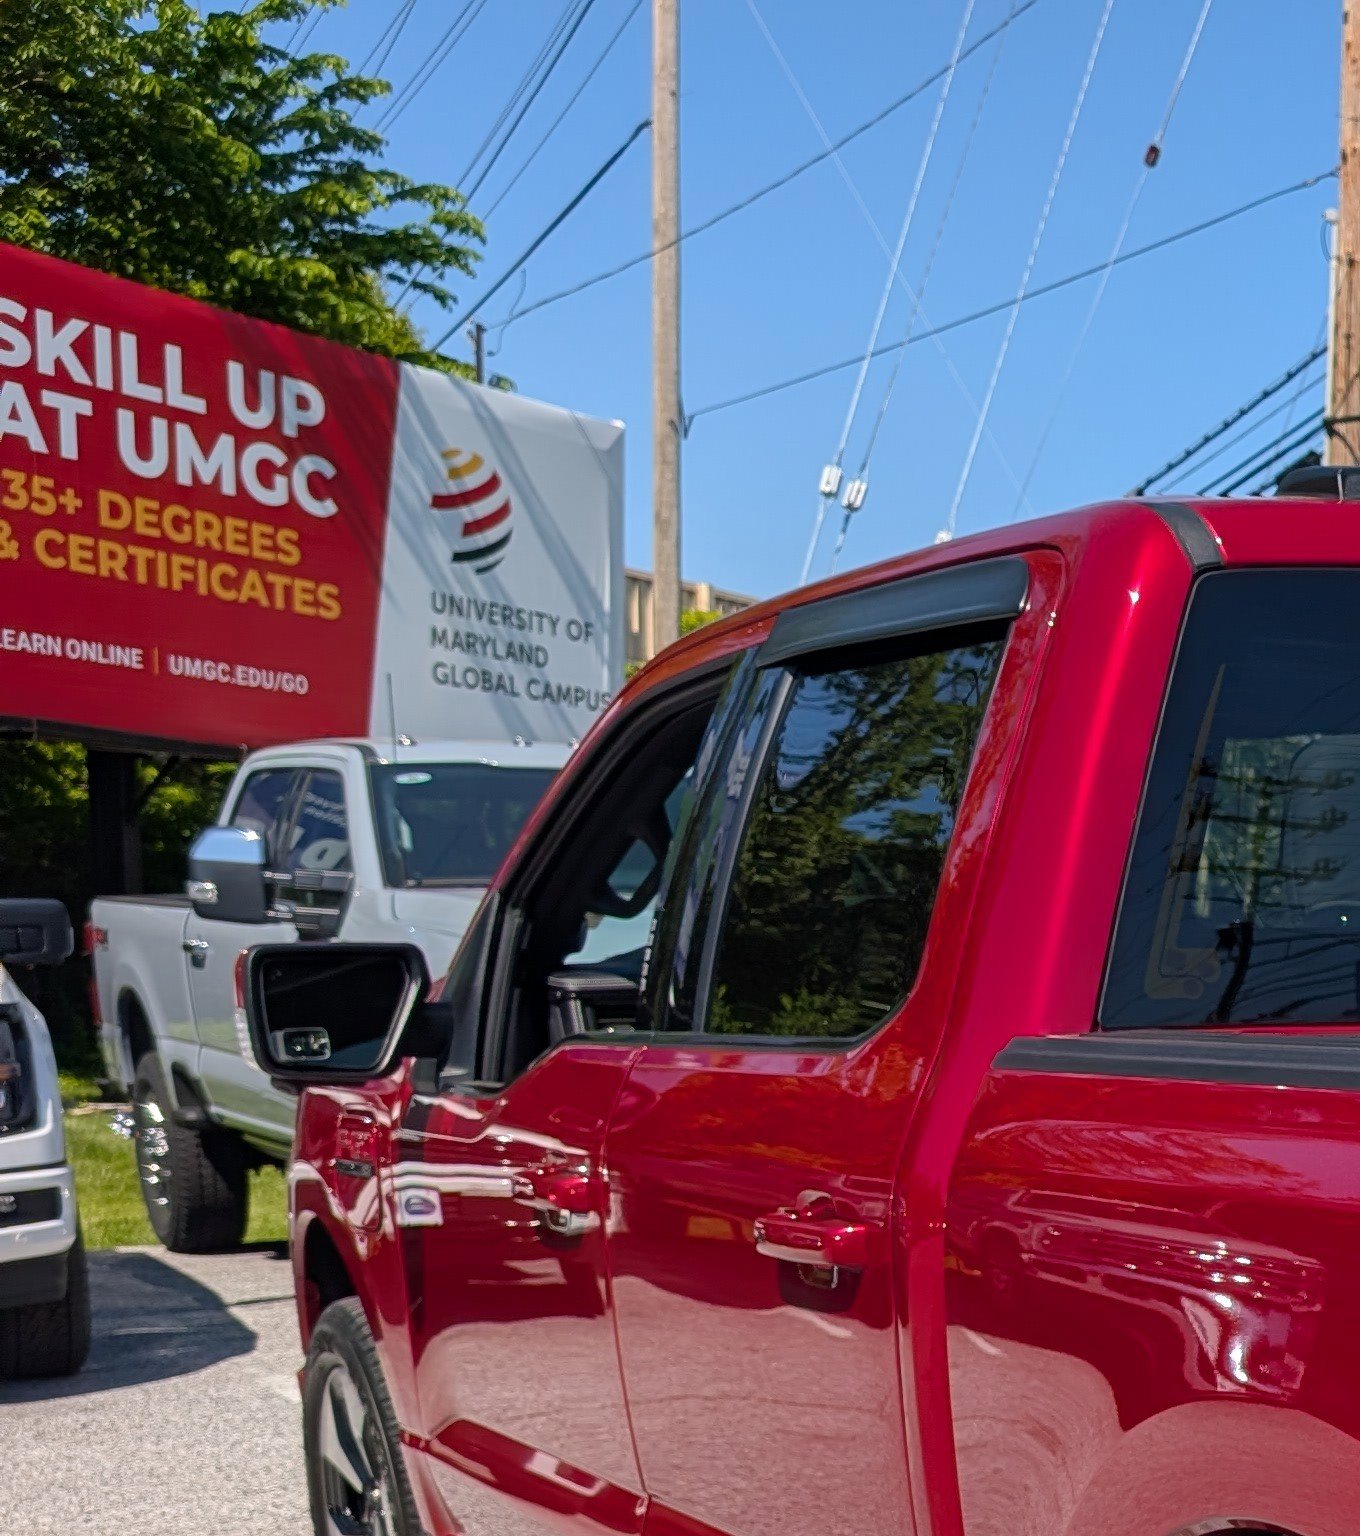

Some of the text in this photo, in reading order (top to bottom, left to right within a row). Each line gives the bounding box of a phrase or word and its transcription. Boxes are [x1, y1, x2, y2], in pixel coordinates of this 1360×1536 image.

[0, 297, 326, 438] SKILL UP
[0, 380, 339, 518] AT UMGC
[2, 468, 301, 567] 35+ DEGREES
[34, 528, 342, 621] CERTIFICATES
[430, 590, 594, 644] UNIVERSITY OF
[430, 624, 549, 669] MARYLAND
[0, 628, 309, 695] EARN ONLINE UMGC.EDU/GO
[431, 660, 521, 698] GLOBAL
